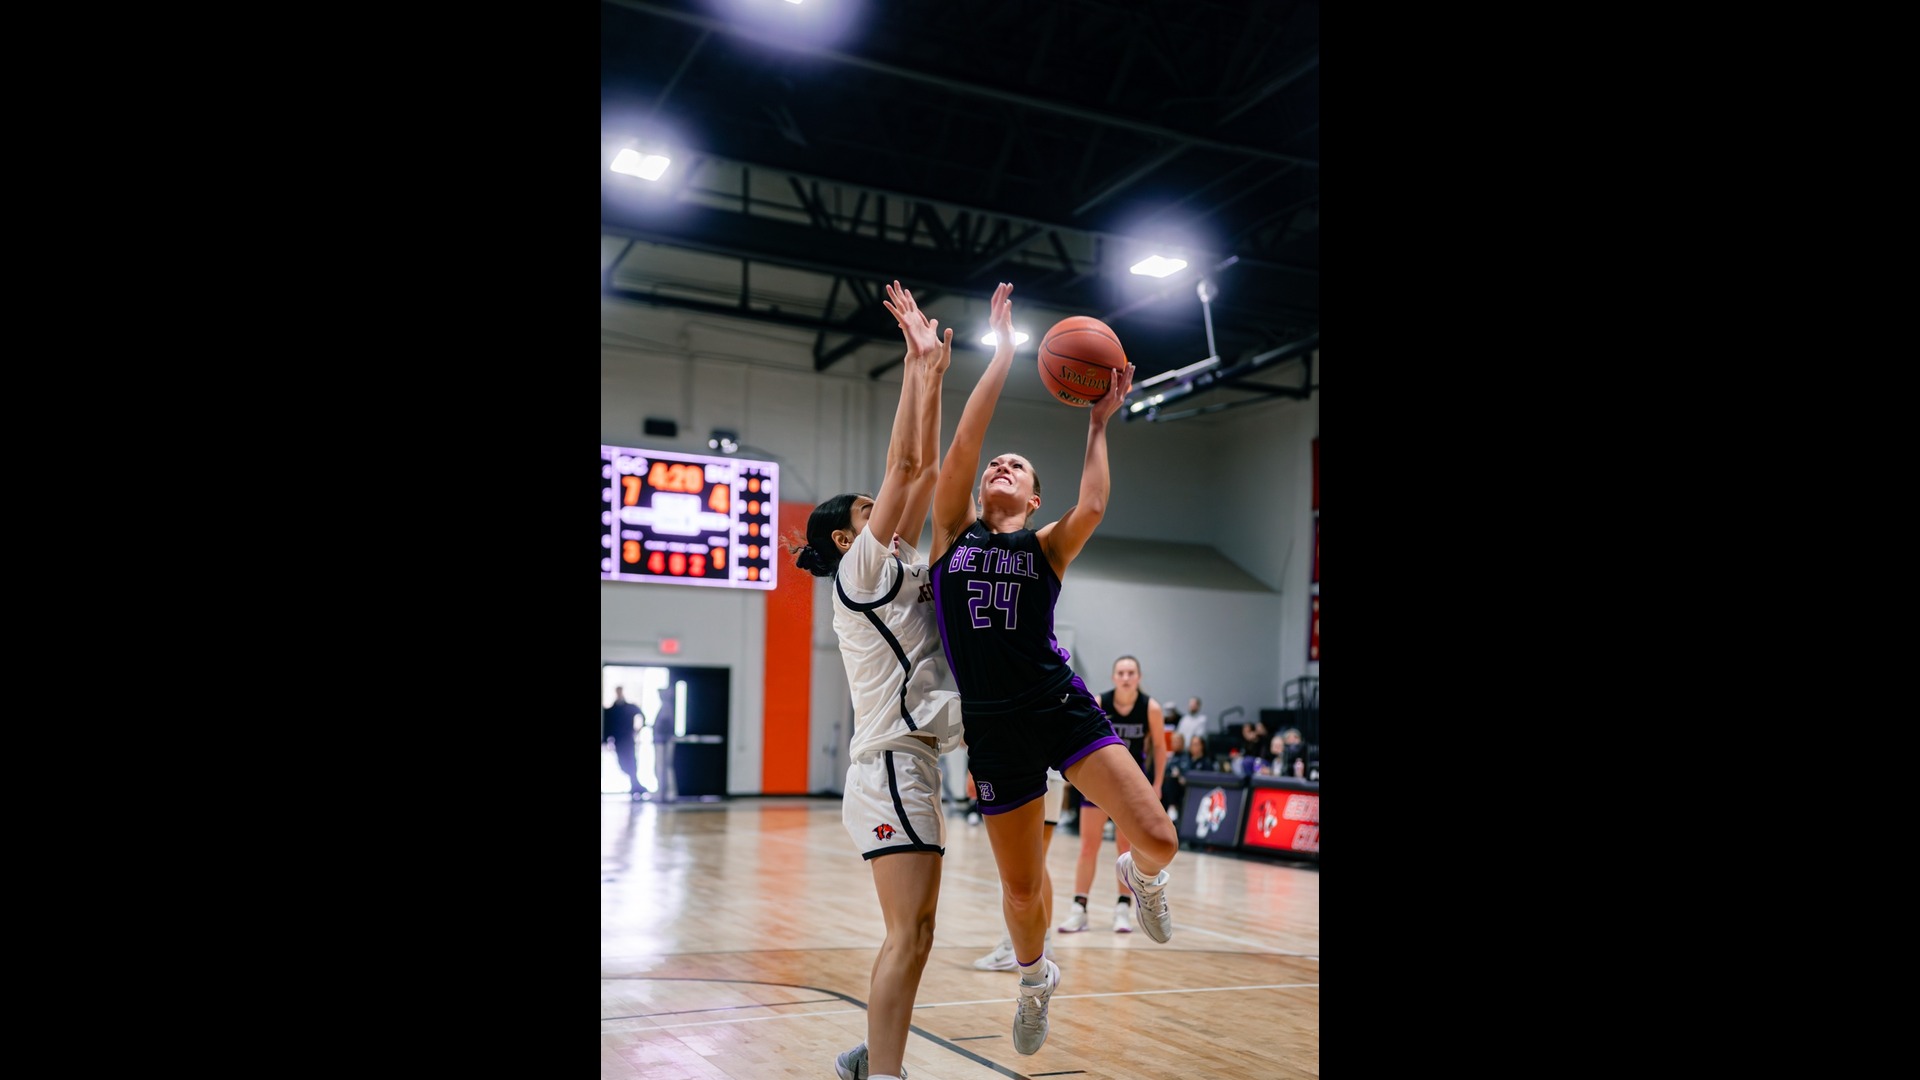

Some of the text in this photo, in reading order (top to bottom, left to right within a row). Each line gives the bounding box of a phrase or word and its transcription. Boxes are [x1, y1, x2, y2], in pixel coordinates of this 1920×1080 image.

[621, 475, 642, 506] 7
[708, 484, 730, 514] 4
[711, 547, 726, 570] 1
[948, 545, 1039, 579] BETHEL
[967, 579, 1021, 630] 24
